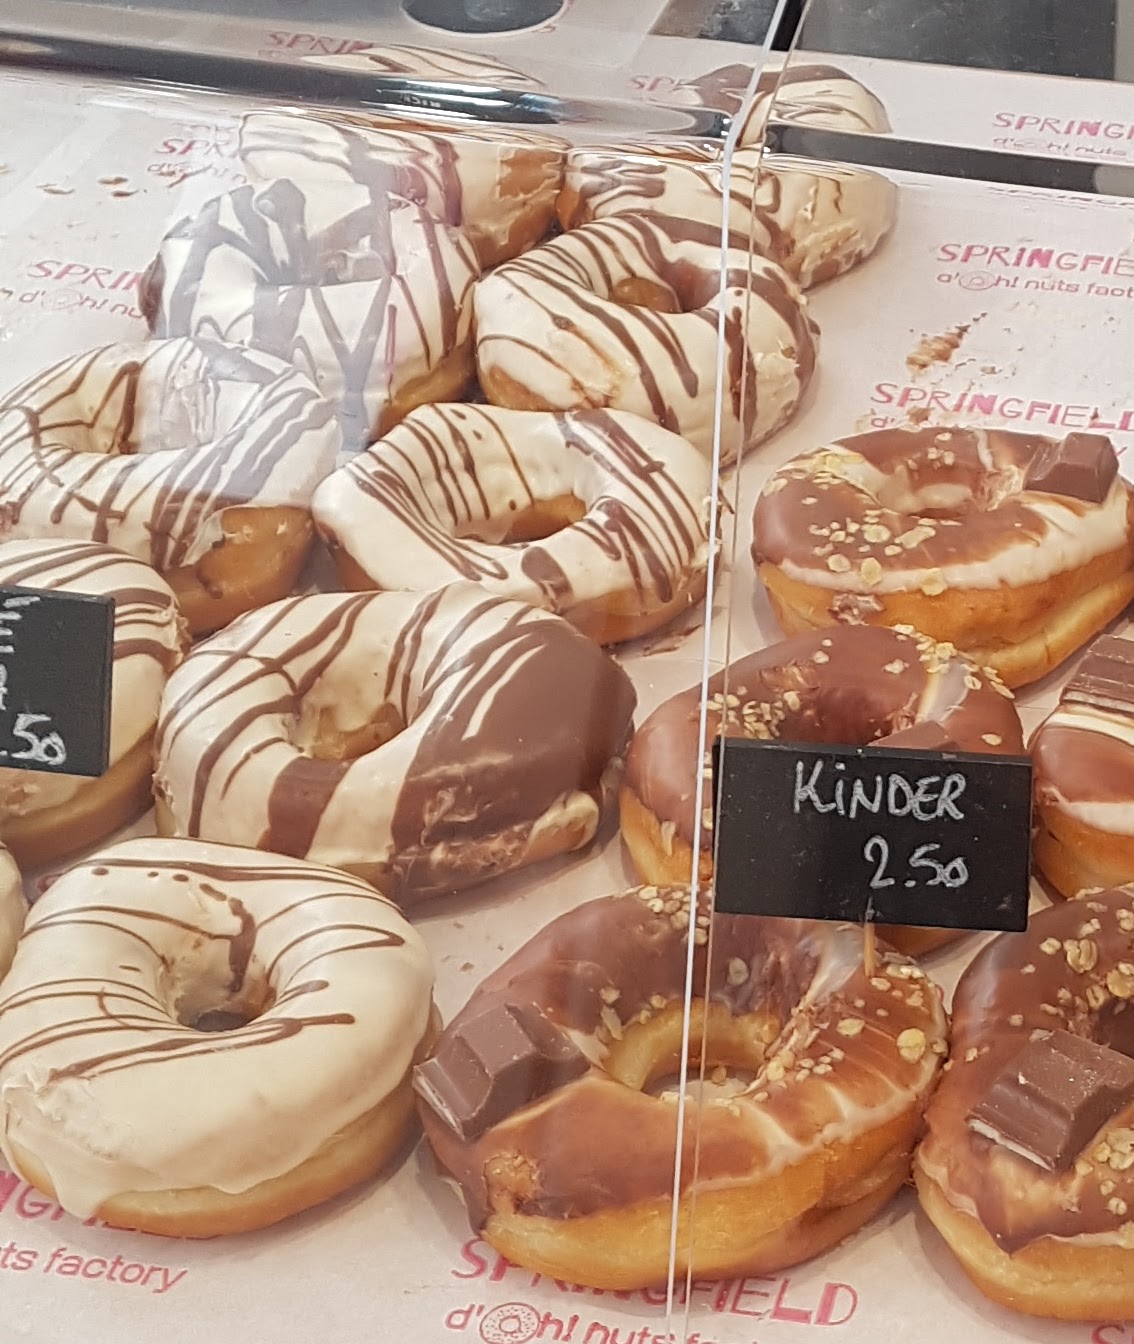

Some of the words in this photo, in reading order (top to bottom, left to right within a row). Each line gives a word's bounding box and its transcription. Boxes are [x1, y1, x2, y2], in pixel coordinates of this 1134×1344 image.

[1025, 277, 1080, 293] nuts
[864, 835, 970, 889] 2.50
[42, 1247, 189, 1294] factory
